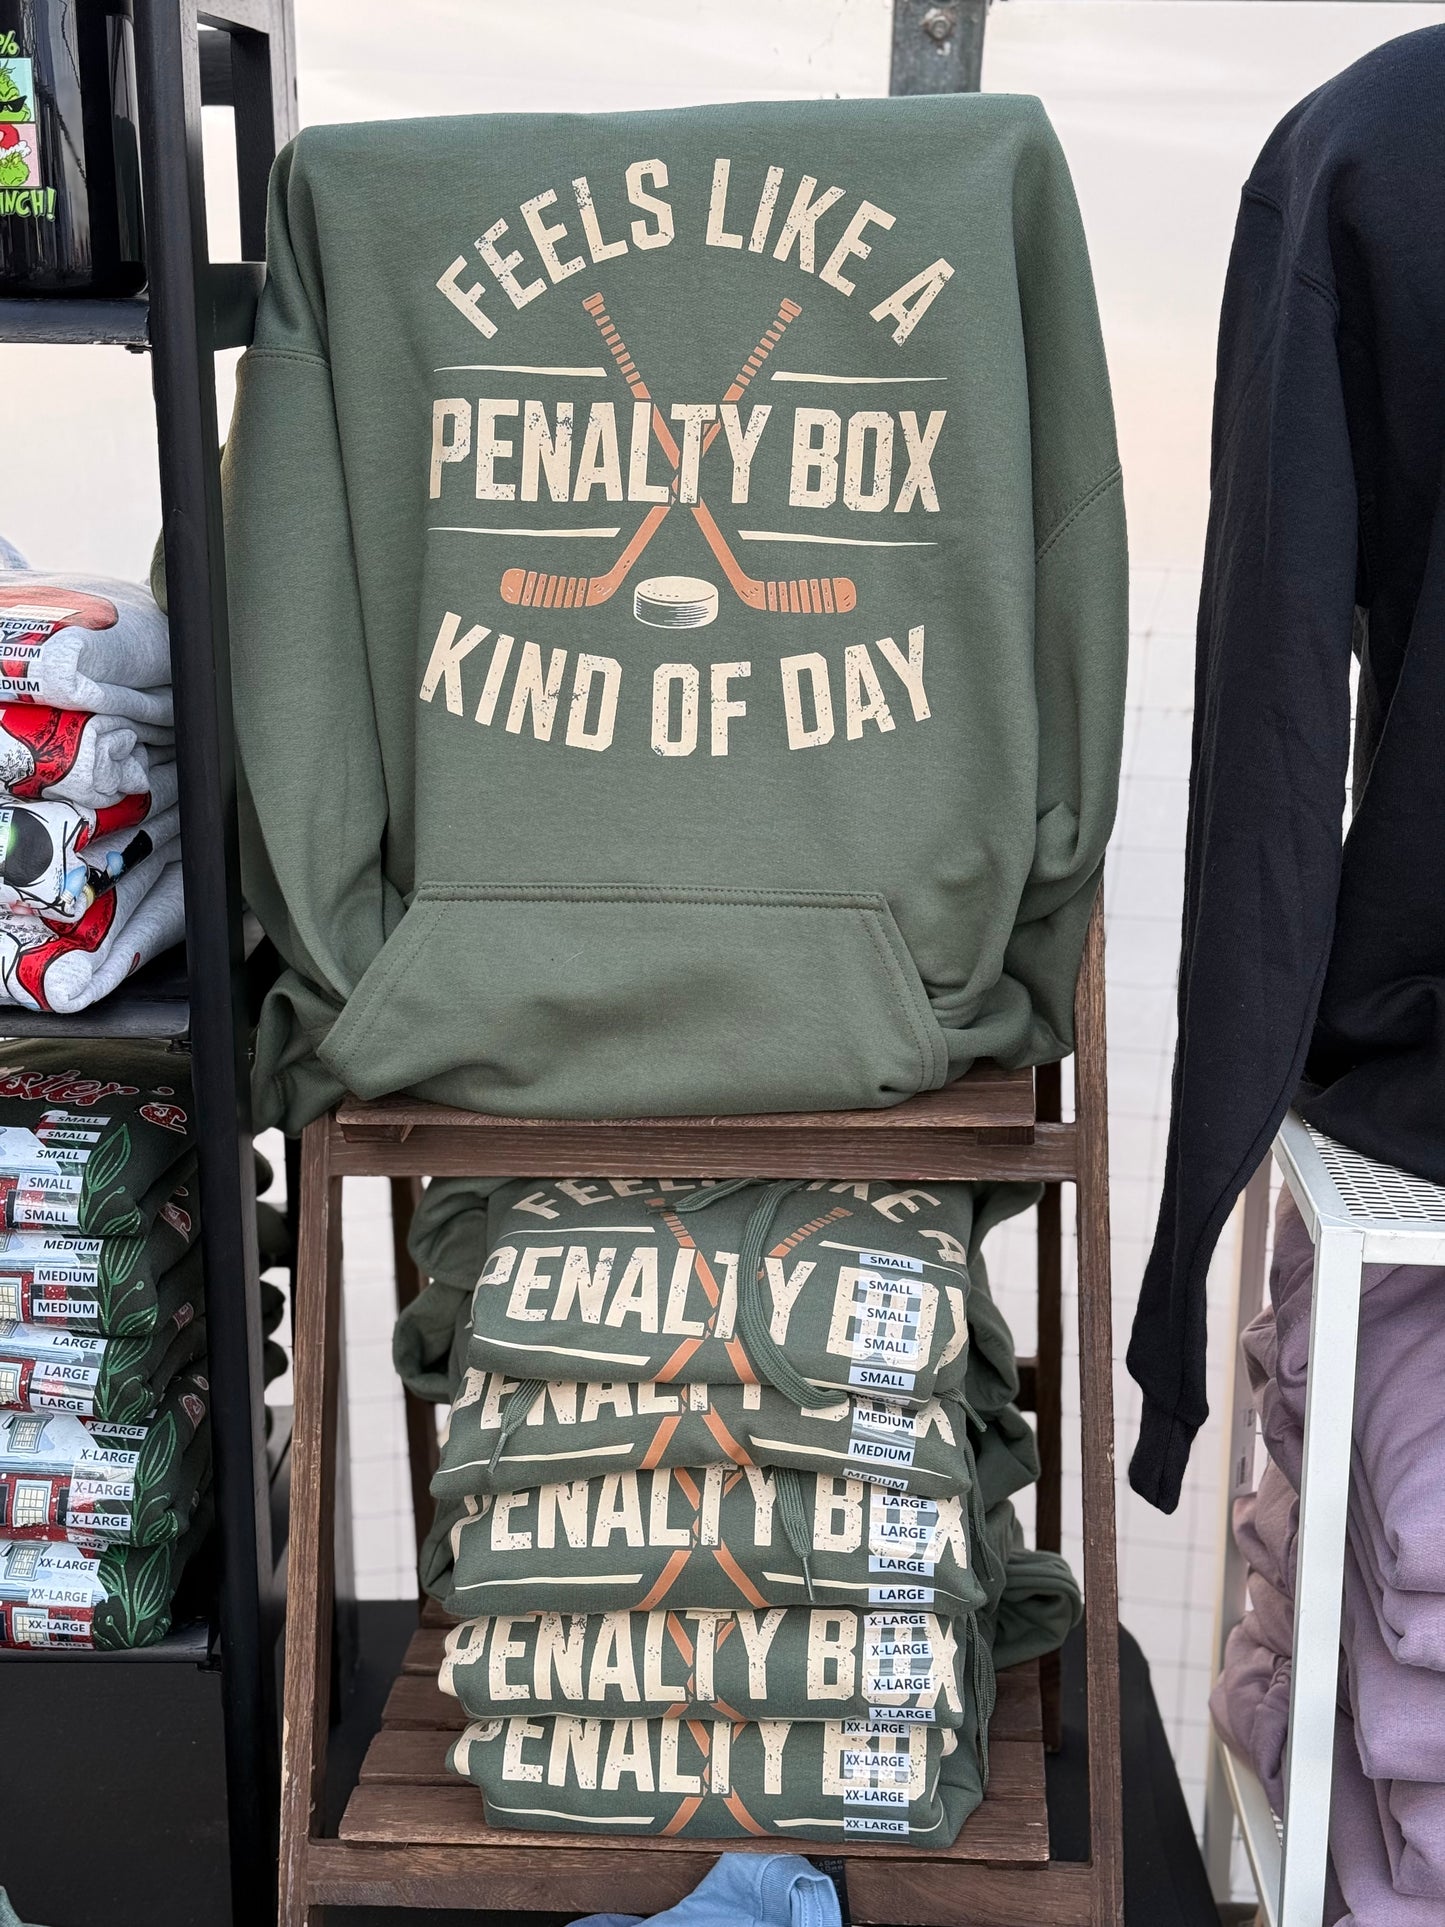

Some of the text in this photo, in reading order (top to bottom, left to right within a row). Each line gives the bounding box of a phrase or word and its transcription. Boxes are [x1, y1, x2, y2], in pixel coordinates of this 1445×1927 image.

[435, 158, 956, 347] FEELS LIKE A
[429, 398, 948, 514] PENALTY BOX
[419, 611, 932, 757] KIND OF DAY
[56, 1115, 100, 1124] SMALL
[46, 1130, 90, 1141] SMALL
[36, 1149, 80, 1160] SMALL
[28, 1177, 73, 1190] SMALL
[24, 1209, 69, 1222] SMALL
[43, 1239, 100, 1252] MEDIUM
[870, 1256, 914, 1270] SMALL
[38, 1270, 95, 1283] MEDIUM
[868, 1280, 913, 1295] SMALL
[470, 1245, 816, 1346] PENALTY
[37, 1302, 95, 1314] MEDIUM
[867, 1307, 912, 1323] SMALL
[52, 1336, 98, 1350] LARGE
[864, 1337, 909, 1354] SMALL
[44, 1365, 90, 1381] LARGE
[860, 1371, 905, 1387] SMALL
[40, 1397, 84, 1411] LARGE
[858, 1410, 914, 1430] MEDIUM
[88, 1422, 145, 1437] X-LARGE
[80, 1450, 136, 1464] X-LARGE
[853, 1443, 911, 1462] MEDIUM
[847, 1471, 905, 1489] MEDIUM
[75, 1481, 131, 1497] X-LARGE
[882, 1496, 928, 1510] LARGE
[71, 1514, 128, 1527] X-LARGE
[880, 1525, 926, 1539] LARGE
[37, 1557, 96, 1571] XX-LARGE
[879, 1558, 925, 1573] LARGE
[30, 1588, 88, 1602] XX-LARGE
[879, 1589, 925, 1600] LARGE
[28, 1619, 86, 1632] XX-LARGE
[870, 1615, 926, 1626] X-LARGE
[871, 1643, 929, 1656] X-LARGE
[438, 1608, 963, 1713] PENALTY BOX
[873, 1677, 931, 1690] X-LARGE
[875, 1709, 932, 1719] X-LARGE
[846, 1722, 905, 1733] XX-LARGE
[846, 1754, 904, 1767] XX-LARGE
[846, 1789, 904, 1802] XX-LARGE
[846, 1820, 904, 1831] XX-LARGE
